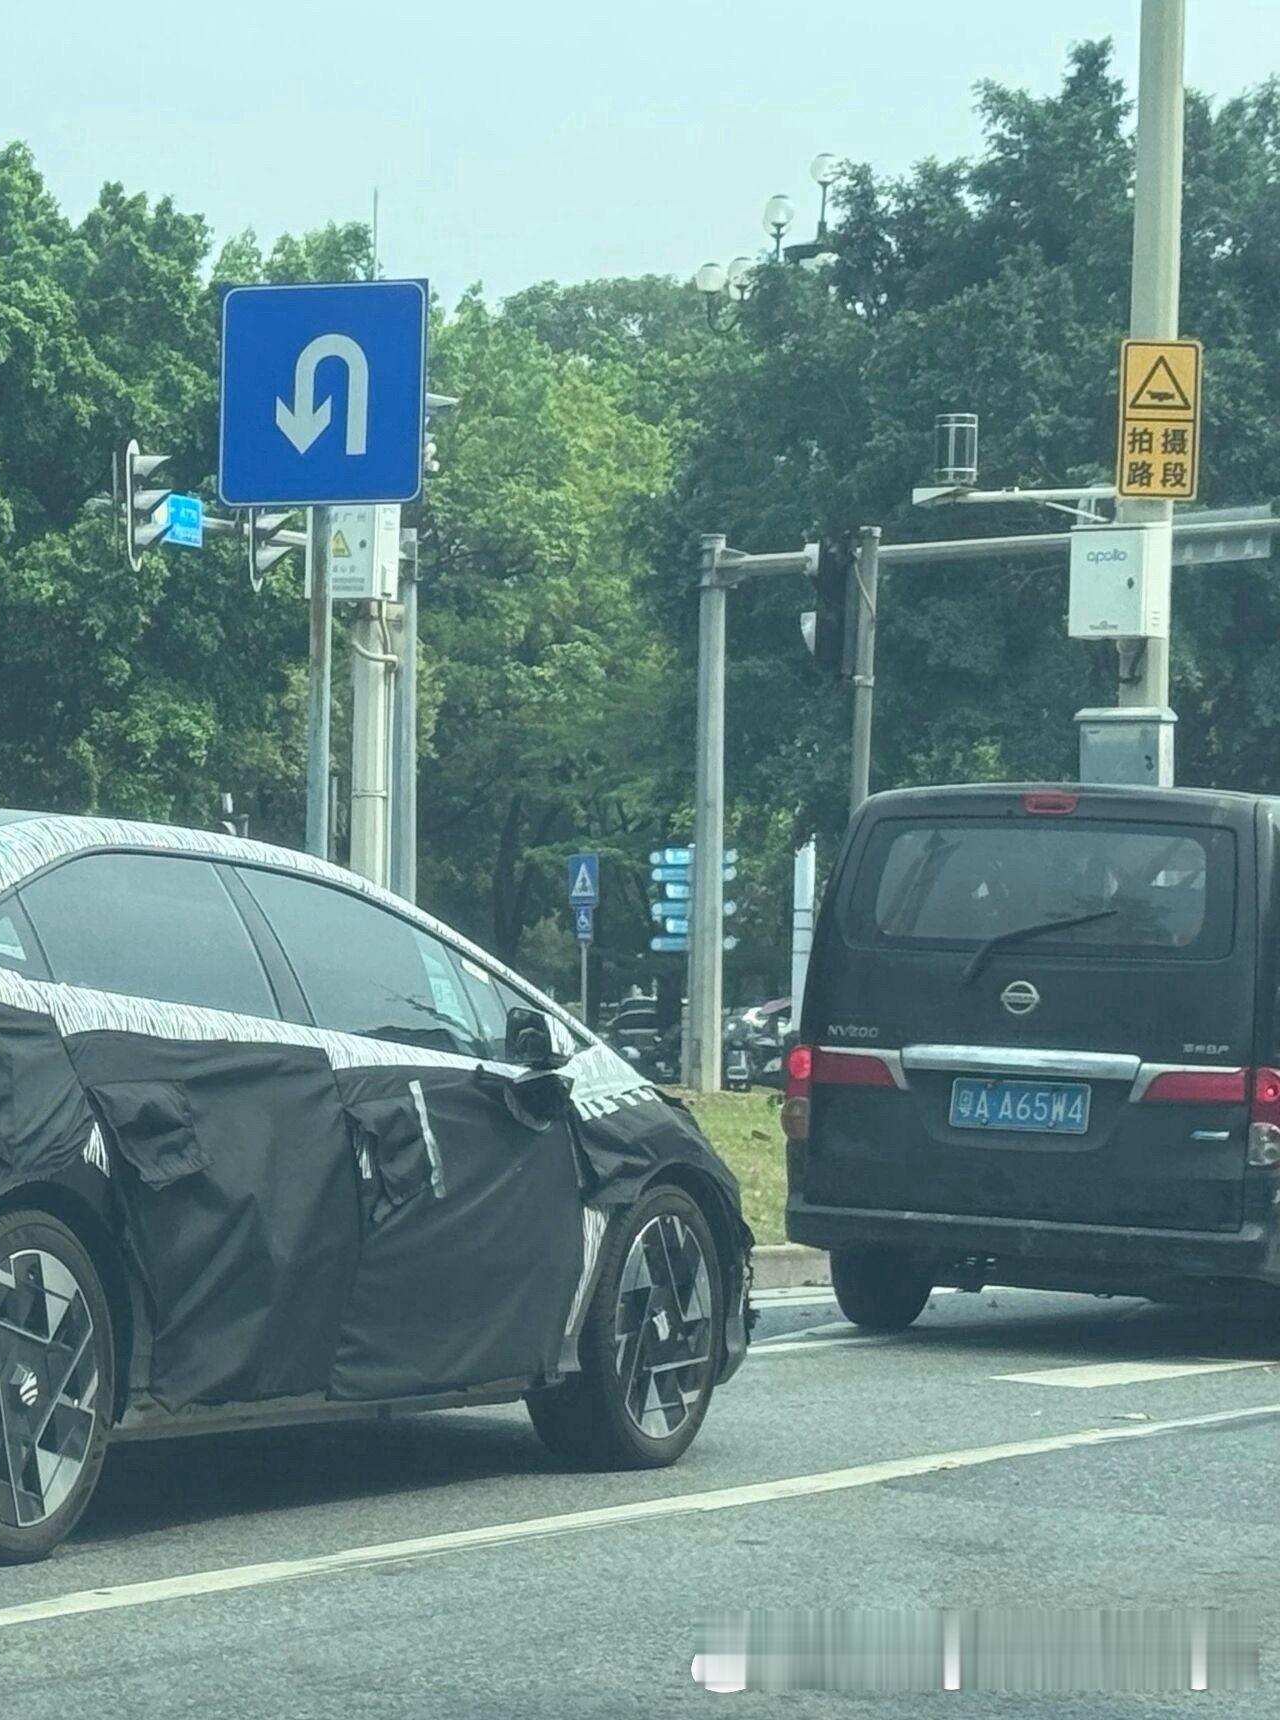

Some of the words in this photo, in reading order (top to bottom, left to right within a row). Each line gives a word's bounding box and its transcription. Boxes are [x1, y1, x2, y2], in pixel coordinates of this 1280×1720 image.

[1127, 426, 1189, 455] 拍摄
[1126, 460, 1188, 488] 路段
[1087, 548, 1127, 565] apollo
[827, 1024, 879, 1038] NV200
